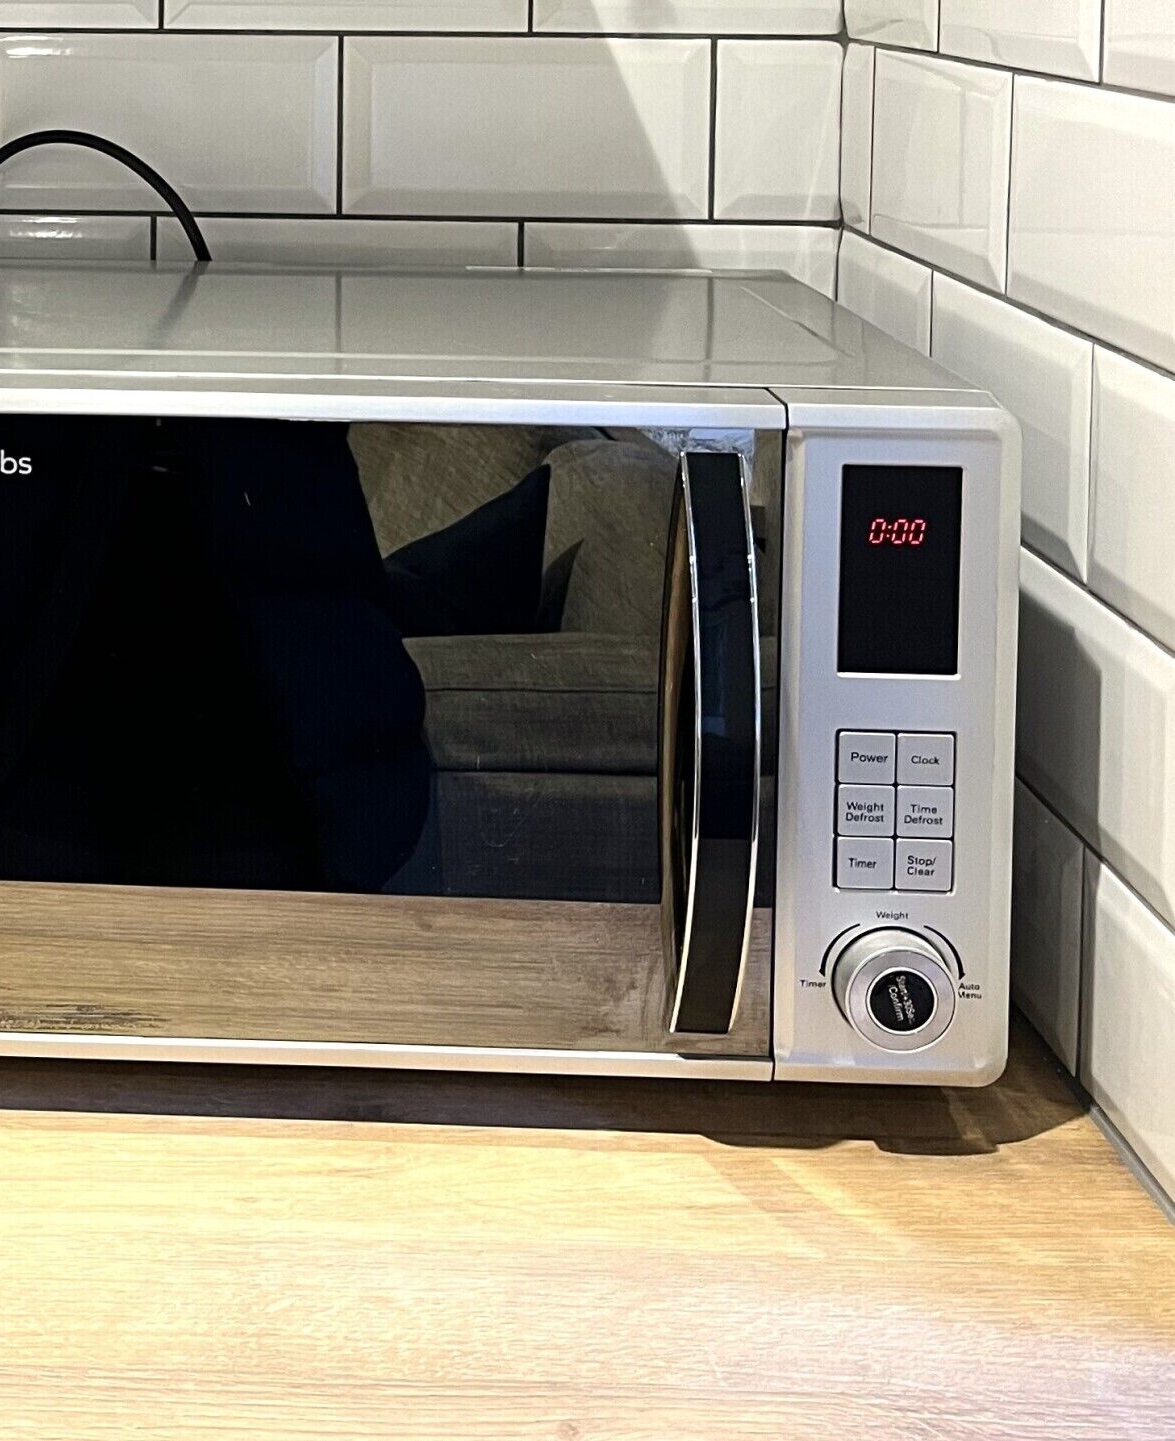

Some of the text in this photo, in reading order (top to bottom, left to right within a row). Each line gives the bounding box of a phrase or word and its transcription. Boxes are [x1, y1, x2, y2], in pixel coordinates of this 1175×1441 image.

[869, 518, 926, 545] 0:00
[850, 751, 889, 764] Power
[910, 755, 940, 766] Clock
[846, 801, 885, 814] Weight
[910, 804, 938, 814] Time
[845, 812, 885, 823] Defrost
[903, 814, 944, 826] Defrost
[848, 857, 878, 869] Timer
[907, 855, 937, 867] Stop/
[906, 866, 936, 877] Clear
[875, 910, 909, 921] Weight
[799, 979, 827, 988] Timer
[958, 982, 981, 991] Auto
[958, 991, 982, 1000] Menu
